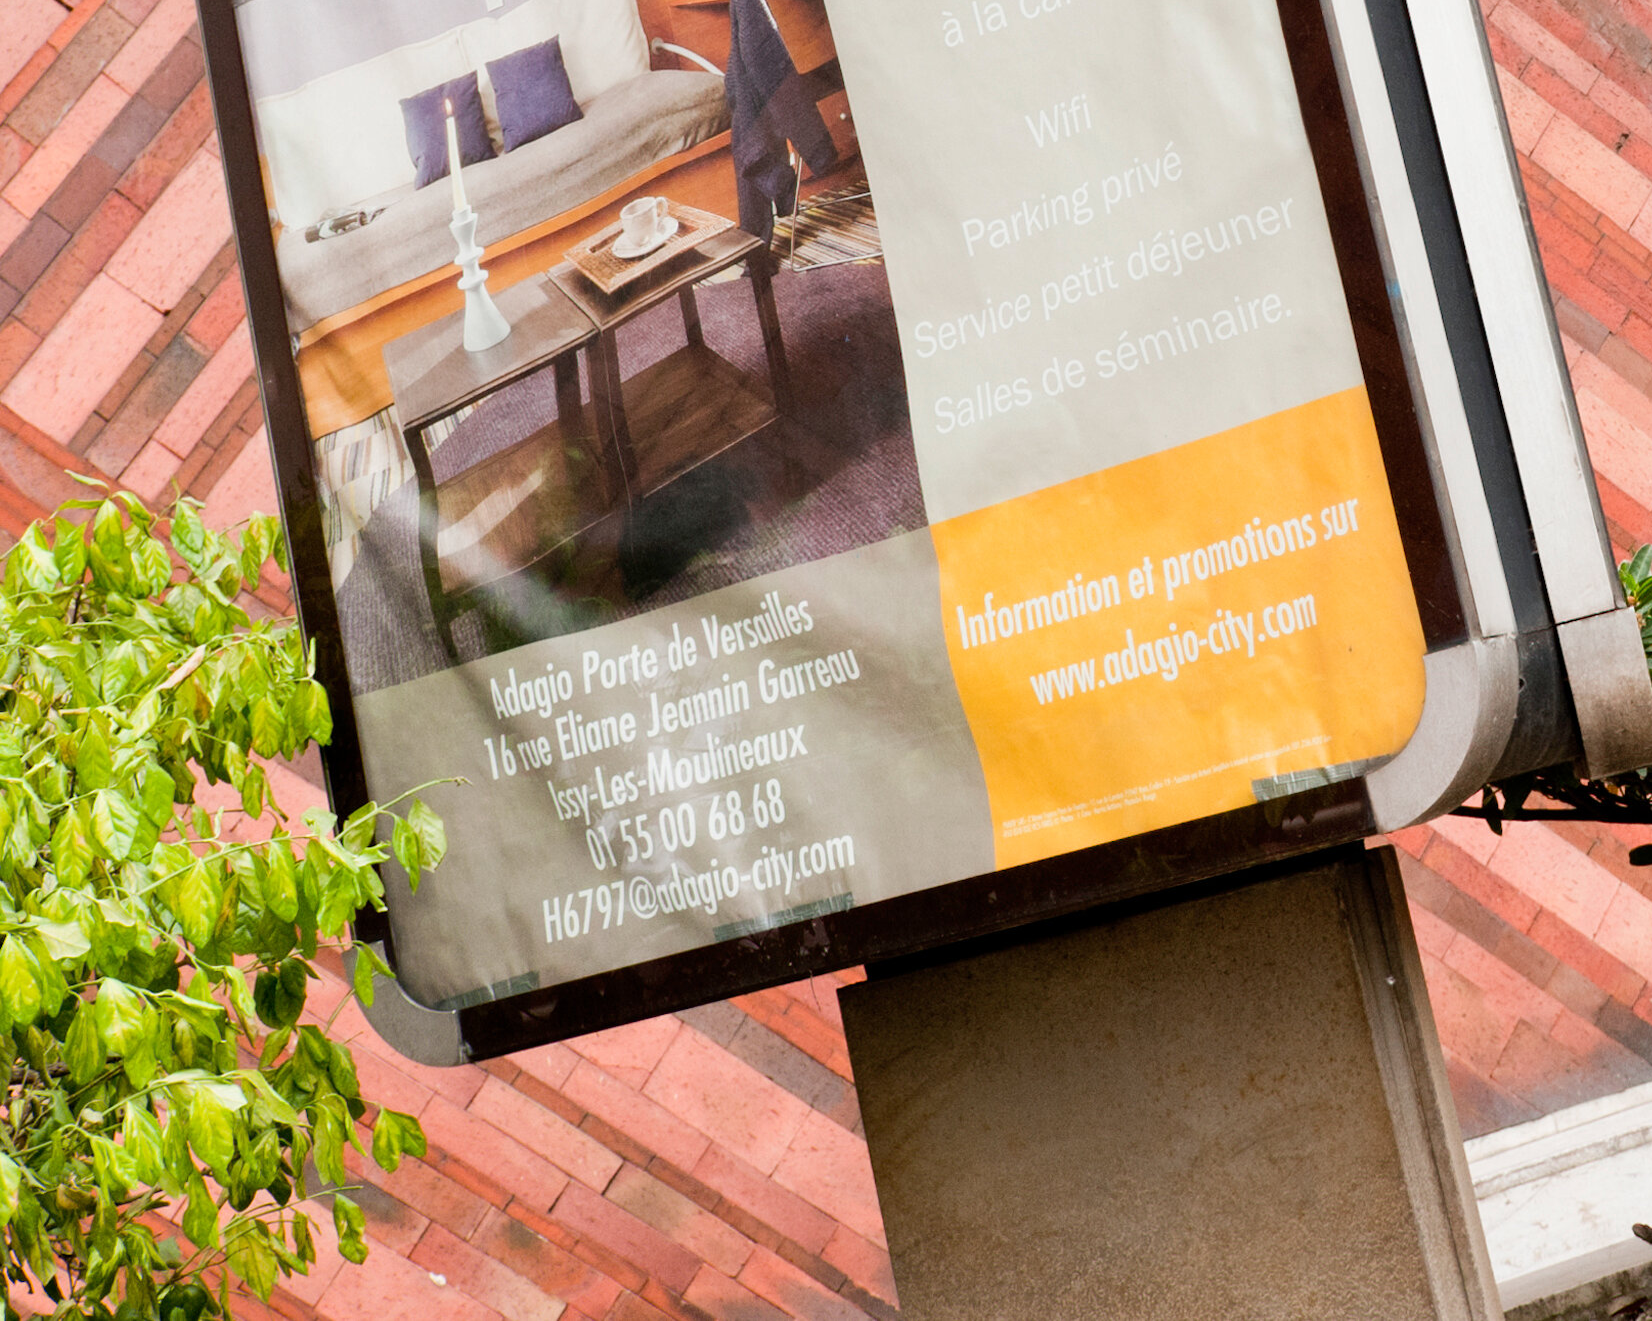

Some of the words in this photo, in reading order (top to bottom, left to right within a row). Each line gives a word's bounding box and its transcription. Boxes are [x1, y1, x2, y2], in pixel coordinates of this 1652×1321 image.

[941, 11, 964, 48] à
[972, 0, 1008, 36] la
[1024, 94, 1094, 149] Wifi
[961, 182, 1095, 257] Parking
[1101, 141, 1183, 215] privé
[913, 292, 1032, 358] Service
[1040, 254, 1120, 321] petit
[1126, 197, 1295, 281] déjeuner
[933, 376, 1033, 435] Salles
[1041, 356, 1086, 398] de
[1095, 292, 1293, 380] séminaire.
[956, 573, 1121, 650] Information
[1128, 556, 1154, 600] et
[1162, 512, 1317, 602] promotions
[1319, 497, 1359, 542] sur
[489, 663, 573, 720] Adagio
[582, 644, 659, 694] Porte
[667, 622, 697, 673] de
[701, 590, 814, 660] Versailles
[1029, 593, 1317, 706] www.adagio-city.com
[484, 734, 517, 780] 16
[520, 735, 553, 773] rue
[555, 709, 637, 762] Eliane
[647, 673, 751, 738] Jeannin
[757, 649, 860, 705] Garreau
[547, 724, 809, 826] Issy-Les-Moulineaux
[585, 826, 617, 871] 01
[619, 814, 654, 864] 55
[658, 803, 697, 853] 00
[707, 791, 746, 841] 68
[752, 778, 785, 829] 68
[542, 834, 856, 943] H6797@adagio-city.com
